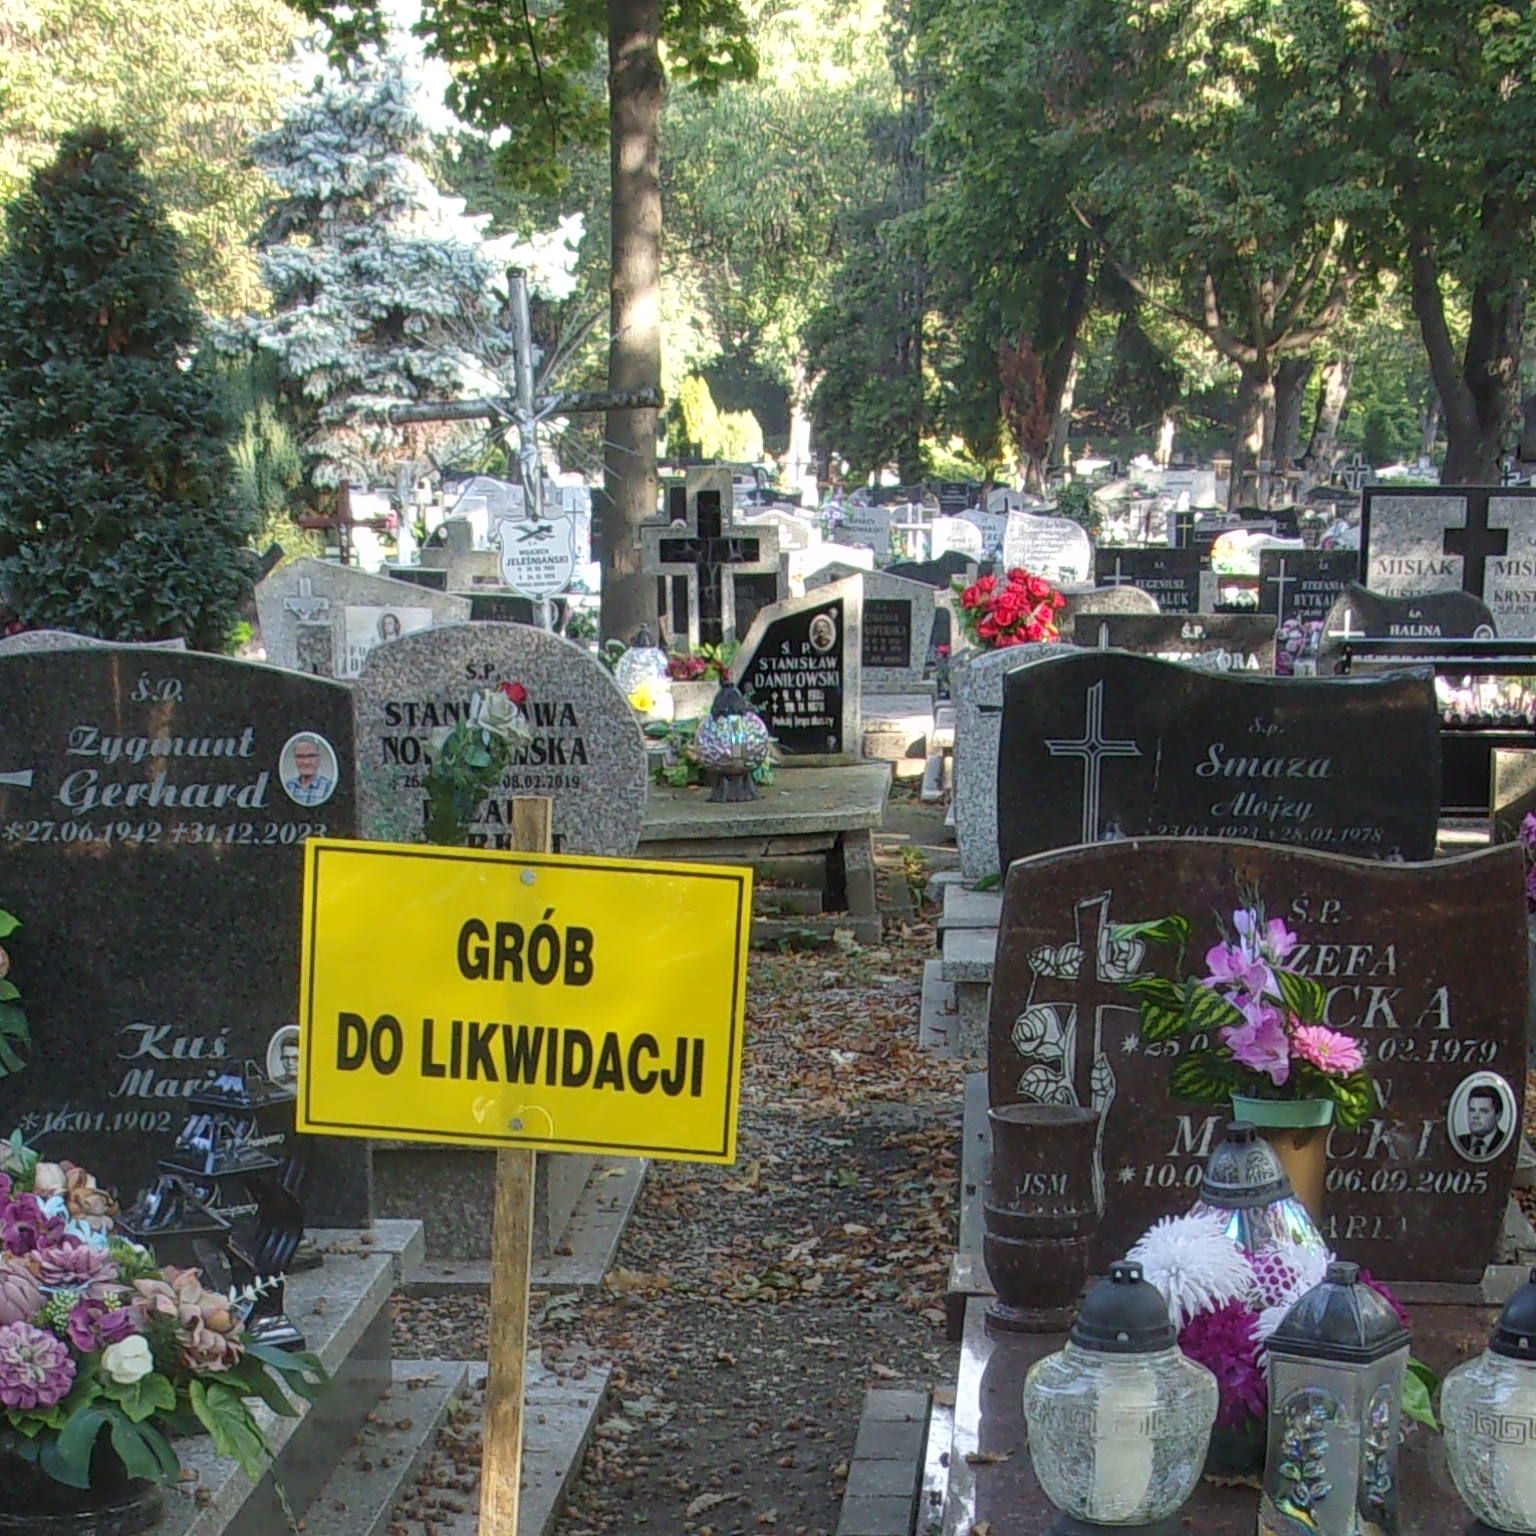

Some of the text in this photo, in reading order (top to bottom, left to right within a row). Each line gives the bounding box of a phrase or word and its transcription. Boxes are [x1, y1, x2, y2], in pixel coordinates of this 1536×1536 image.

[1378, 560, 1455, 575] MISIAK
[1390, 624, 1442, 637] HALINA
[754, 671, 840, 688] DANIŁOWSKI
[758, 656, 838, 671] STANISŁAW
[66, 726, 256, 764] Zygmunt
[1195, 743, 1332, 779] Smaza
[53, 769, 271, 815] Gerhard
[1211, 791, 1316, 822] Alojzy
[457, 908, 595, 986] GRÓB
[1280, 944, 1397, 976] ZEFA
[117, 1023, 232, 1060] Kuś
[337, 1012, 704, 1097] DO LIKWIDACJI
[108, 1068, 218, 1099] Mari
